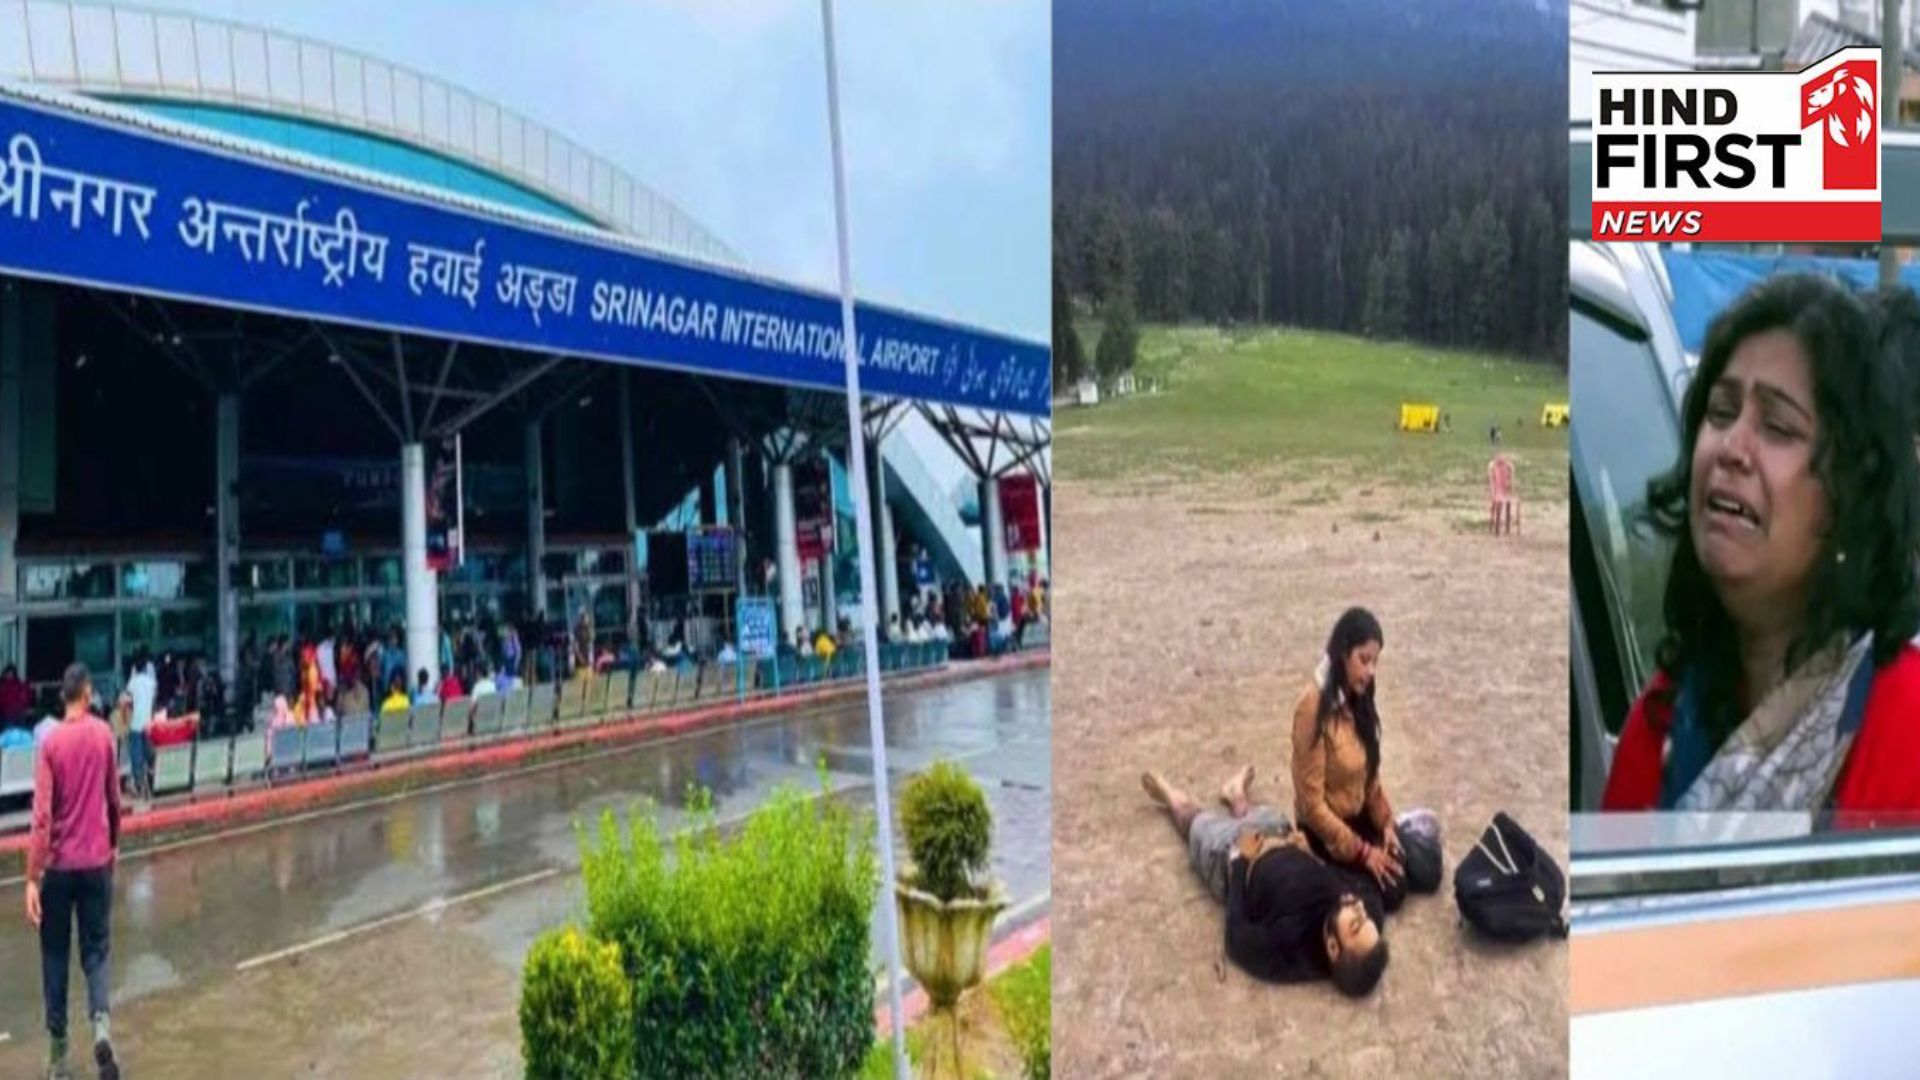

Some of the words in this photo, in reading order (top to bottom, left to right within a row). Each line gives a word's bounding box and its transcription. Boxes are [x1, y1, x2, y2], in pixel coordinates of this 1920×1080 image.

[407, 238, 486, 309] हवाई
[496, 263, 577, 327] अड्डा
[590, 280, 718, 340] SRINAGAR
[720, 306, 866, 366] INTERNATIONL
[869, 336, 940, 377] AIRPORT
